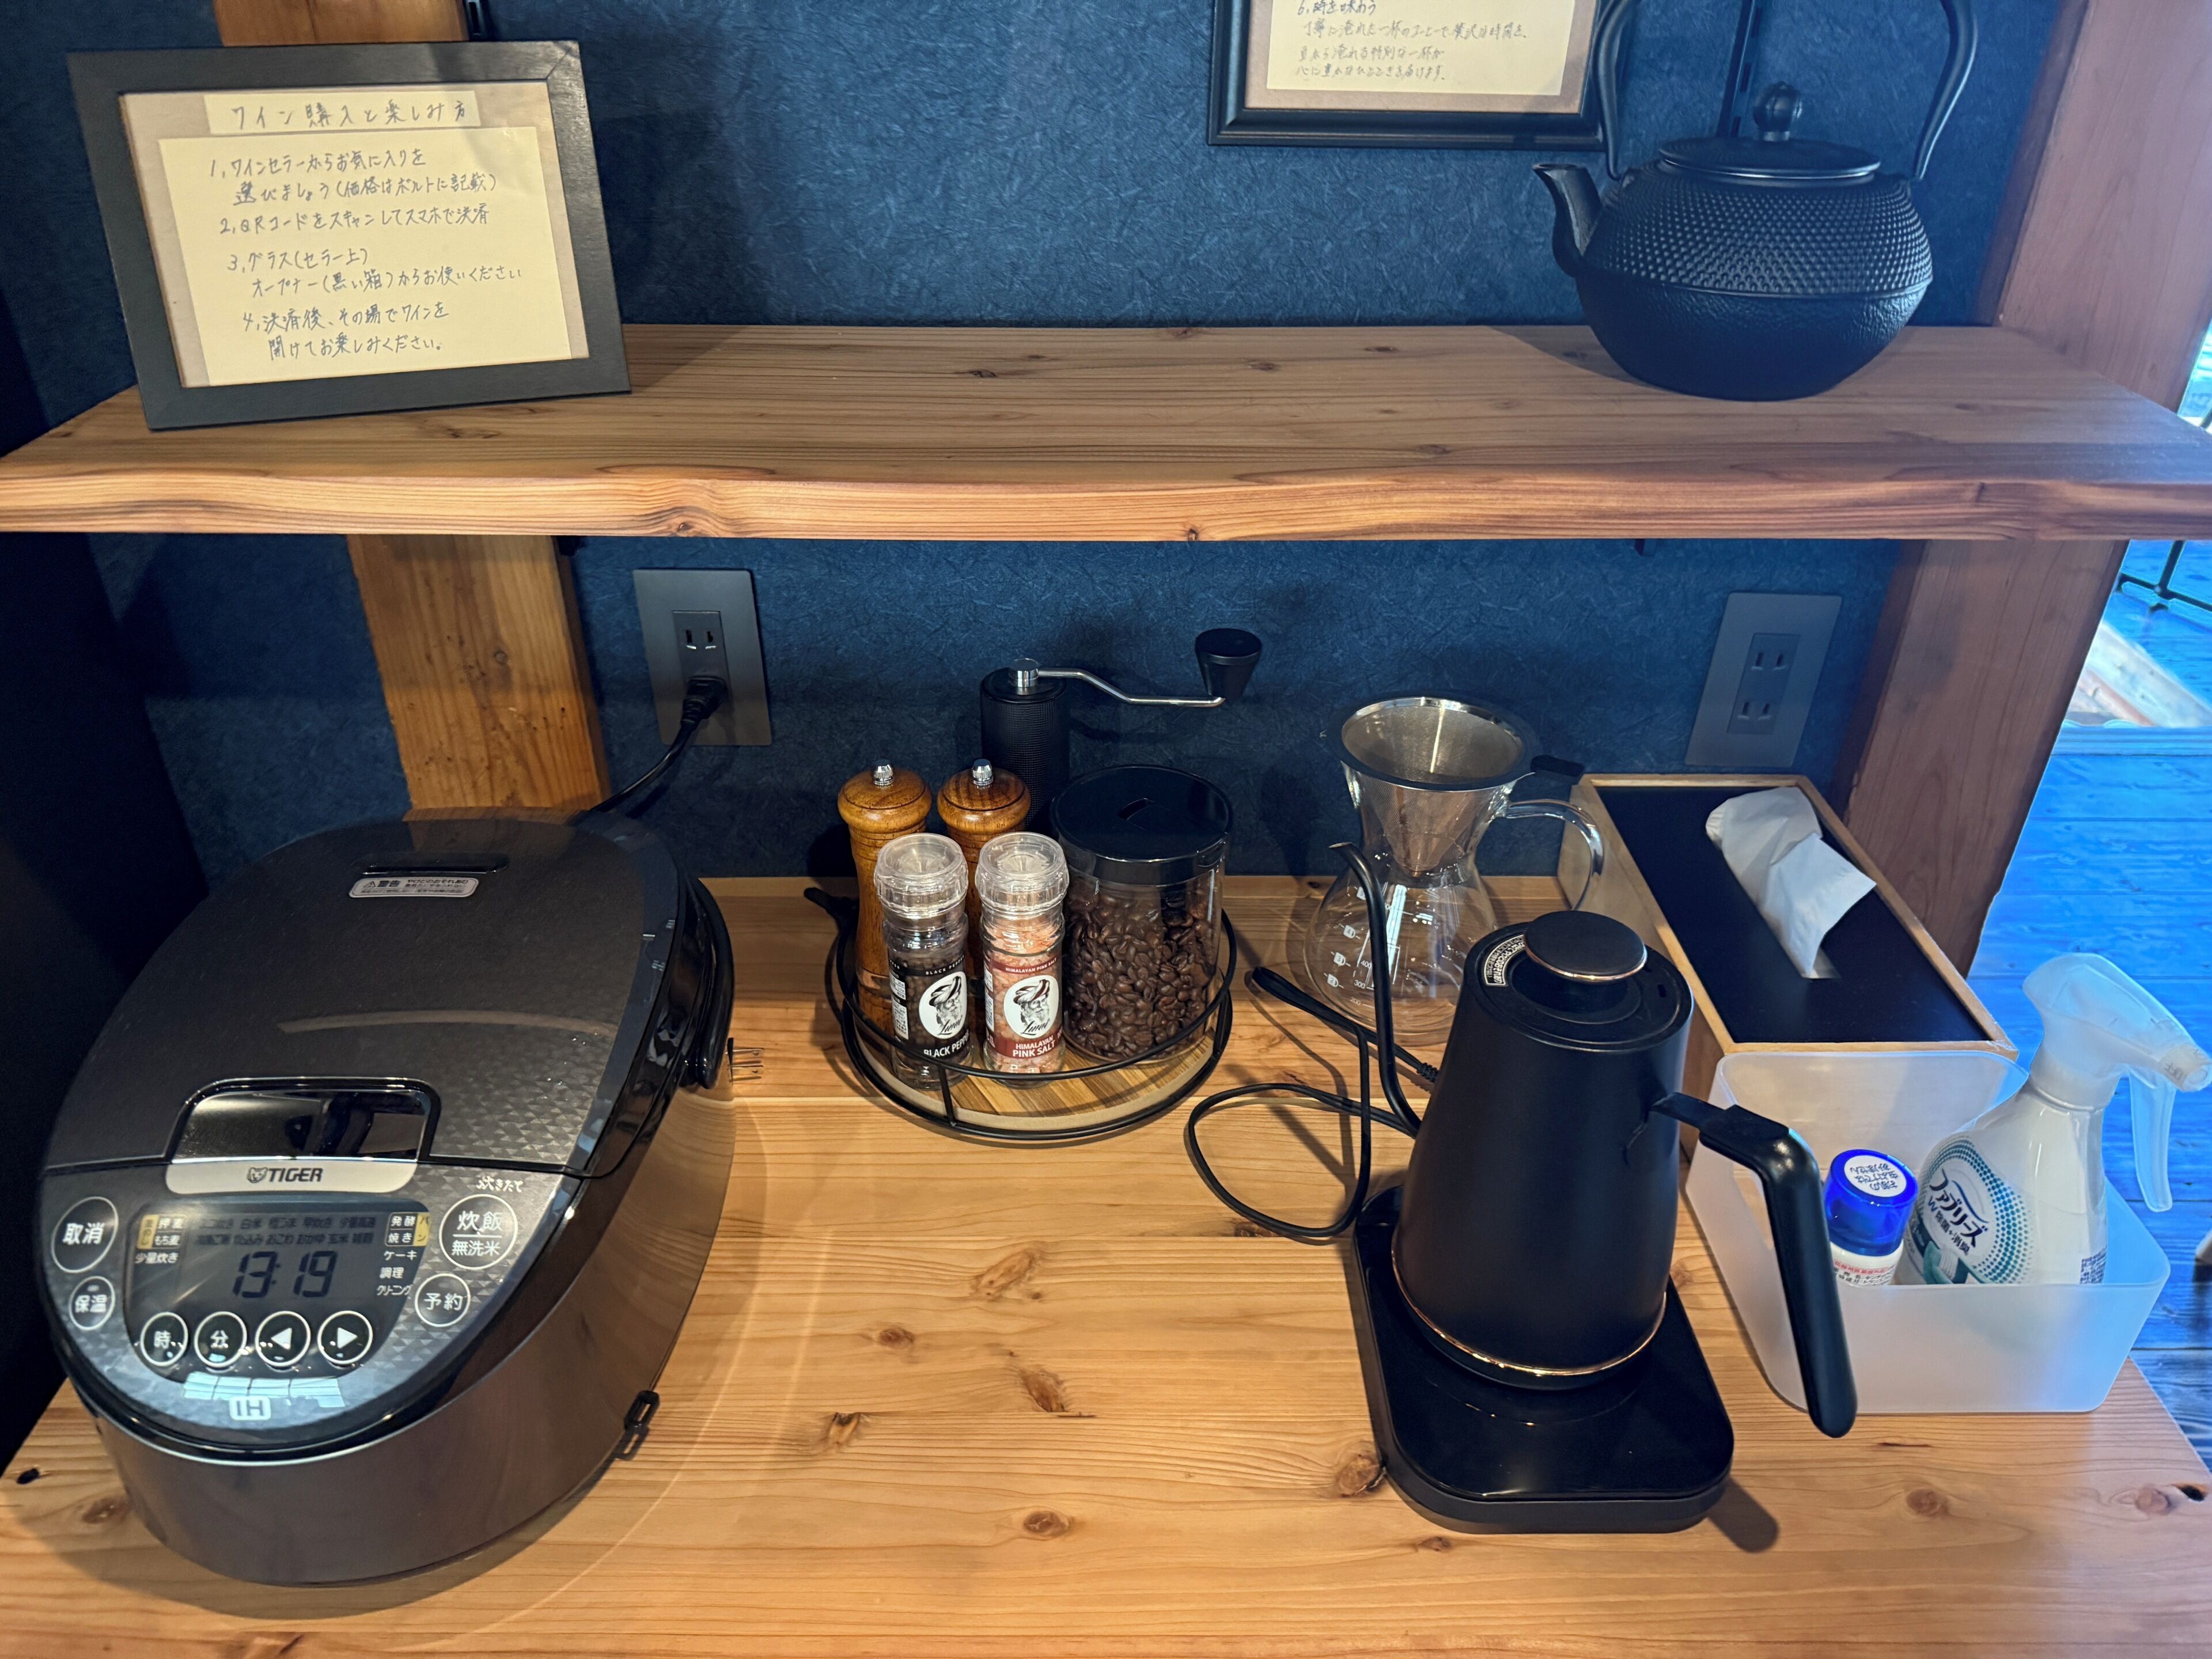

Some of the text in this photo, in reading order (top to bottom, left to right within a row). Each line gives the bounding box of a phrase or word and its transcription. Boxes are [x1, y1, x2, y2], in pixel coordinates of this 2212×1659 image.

[1048, 957, 1057, 967] SALT
[1354, 979, 1365, 989] 300
[1350, 996, 1361, 1005] 200
[1013, 1040, 1056, 1058] PINK SALT
[1016, 1035, 1053, 1050] HIMALAYAN
[923, 1046, 950, 1058] BLACK
[268, 1168, 324, 1182] TIGER
[1929, 1168, 1988, 1248] ファブリーズ
[391, 1216, 416, 1226] 発酵
[457, 1210, 504, 1232] 炊飯
[63, 1222, 105, 1245] 取消
[388, 1233, 412, 1243] 焼き
[384, 1250, 418, 1260] ケーキ
[452, 1240, 500, 1256] 無洗米
[135, 1252, 179, 1264] 少量炊き
[75, 1294, 108, 1313] 保温
[424, 1293, 463, 1310] 予約
[154, 1331, 171, 1349] 時
[211, 1330, 229, 1349] 分
[236, 1400, 264, 1417] IH
